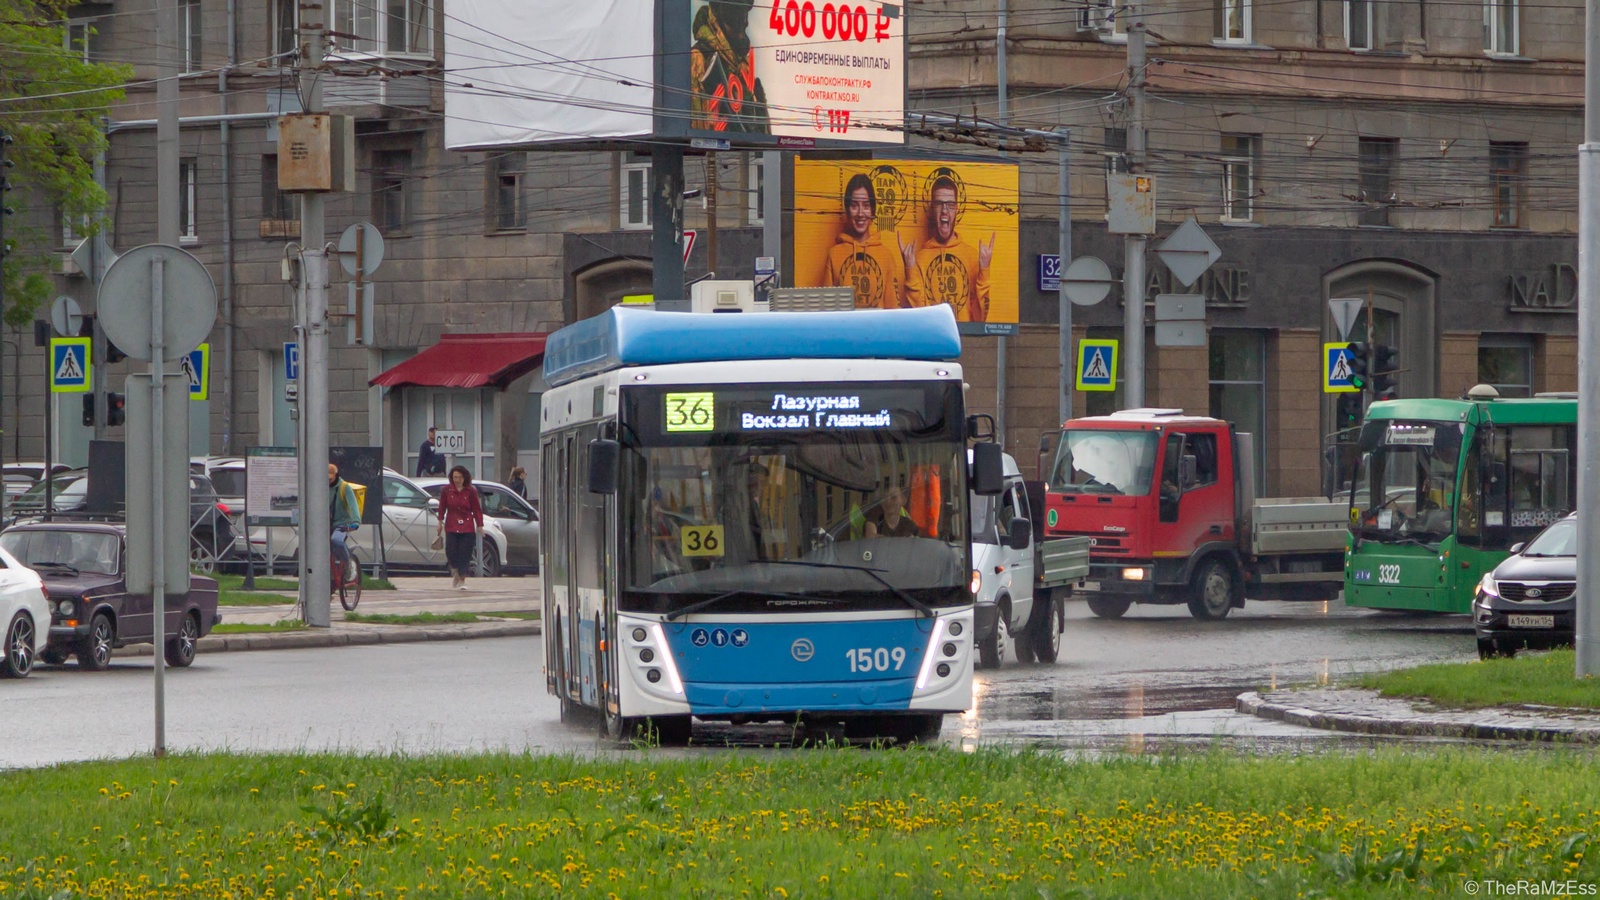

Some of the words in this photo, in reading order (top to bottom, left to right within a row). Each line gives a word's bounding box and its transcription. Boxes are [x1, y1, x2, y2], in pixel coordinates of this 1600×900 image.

[769, 0, 816, 38] 400
[822, 3, 868, 42] 000
[775, 49, 850, 67] ЕДИНОВРЕМЕННЫЕ
[852, 55, 891, 70] ВЫПЛАТЫ
[794, 74, 872, 89] СЛУЖБАПОКОНТРАКТУ.РФ
[806, 90, 860, 102] KONTRAKT.NSO.RU
[827, 109, 850, 133] 117
[876, 188, 895, 205] 30
[1045, 258, 1060, 276] 32
[669, 398, 710, 425] 36
[771, 394, 860, 411] Лазурная
[741, 412, 809, 428] Вокзал
[815, 410, 890, 427] Главный
[687, 530, 718, 551] 36
[1378, 564, 1400, 584] 3322
[846, 647, 906, 673] 1509
